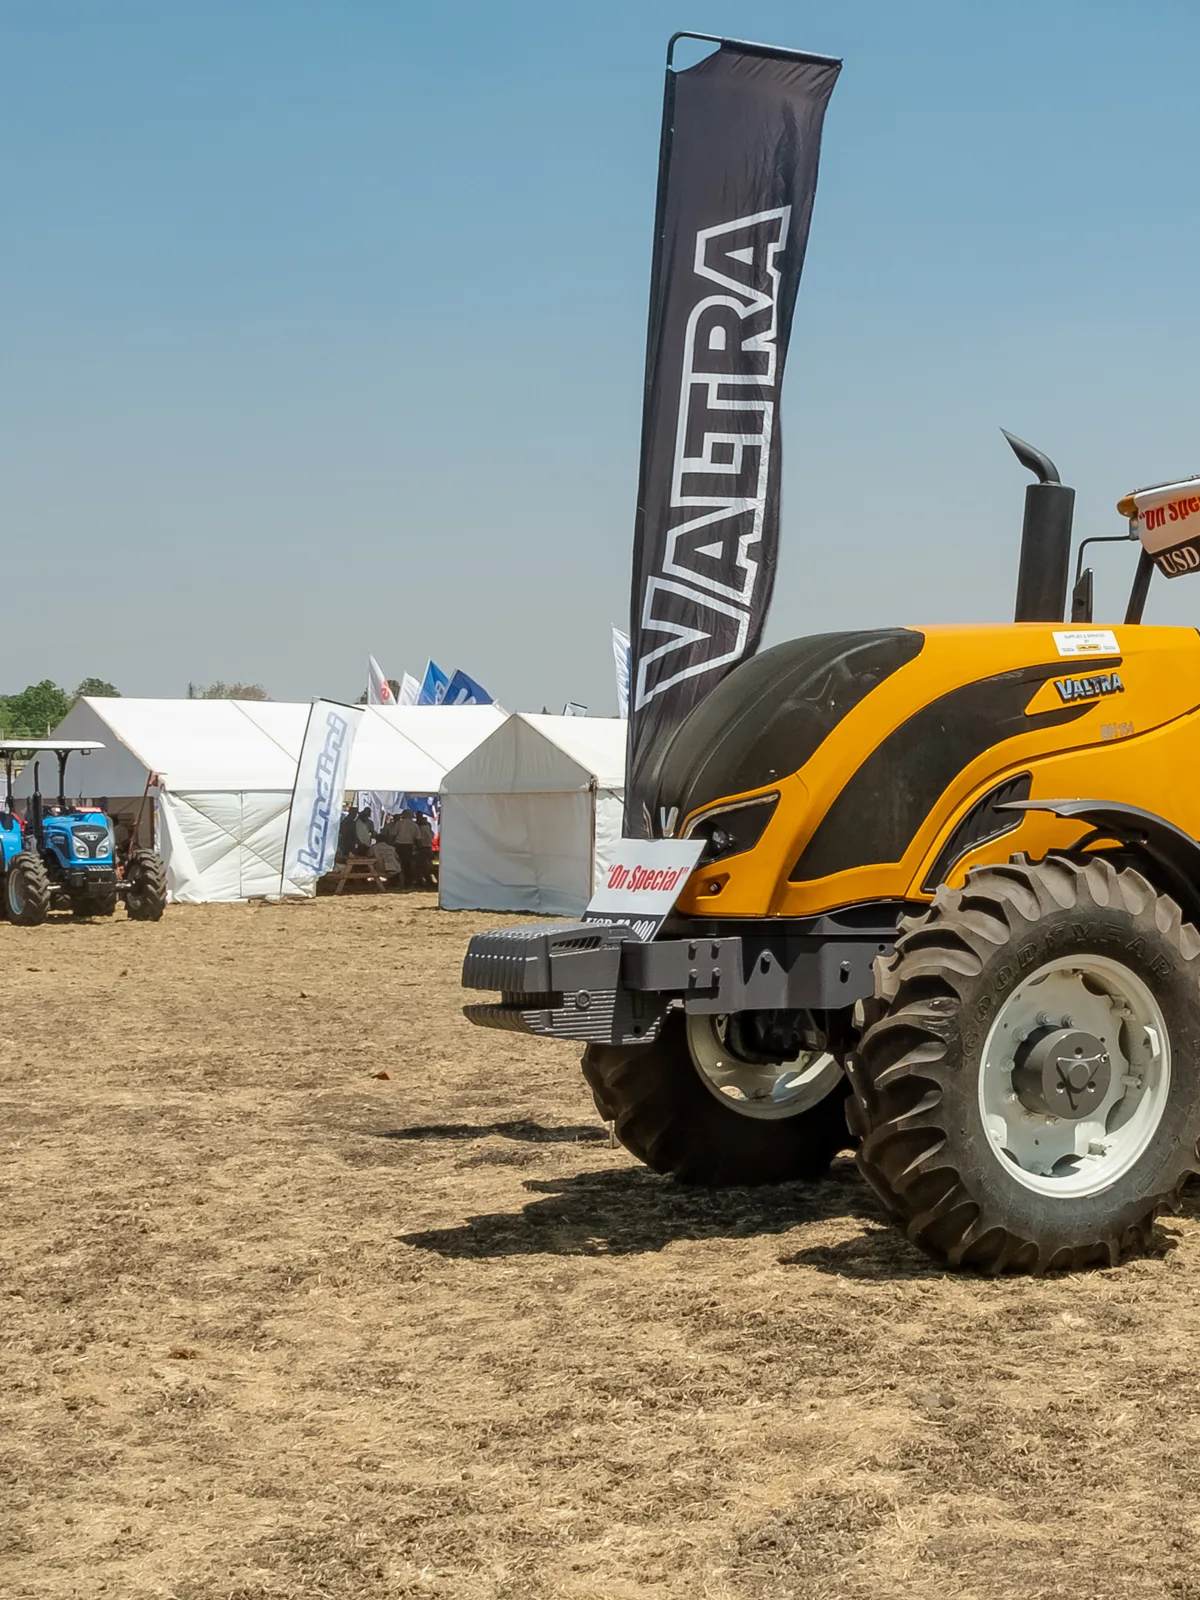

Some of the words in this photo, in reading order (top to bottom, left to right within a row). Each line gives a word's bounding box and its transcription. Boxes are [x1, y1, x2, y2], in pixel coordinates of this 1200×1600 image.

[634, 204, 793, 713] VALTRA
[1159, 546, 1200, 574] USD
[1054, 674, 1124, 703] VALTRA
